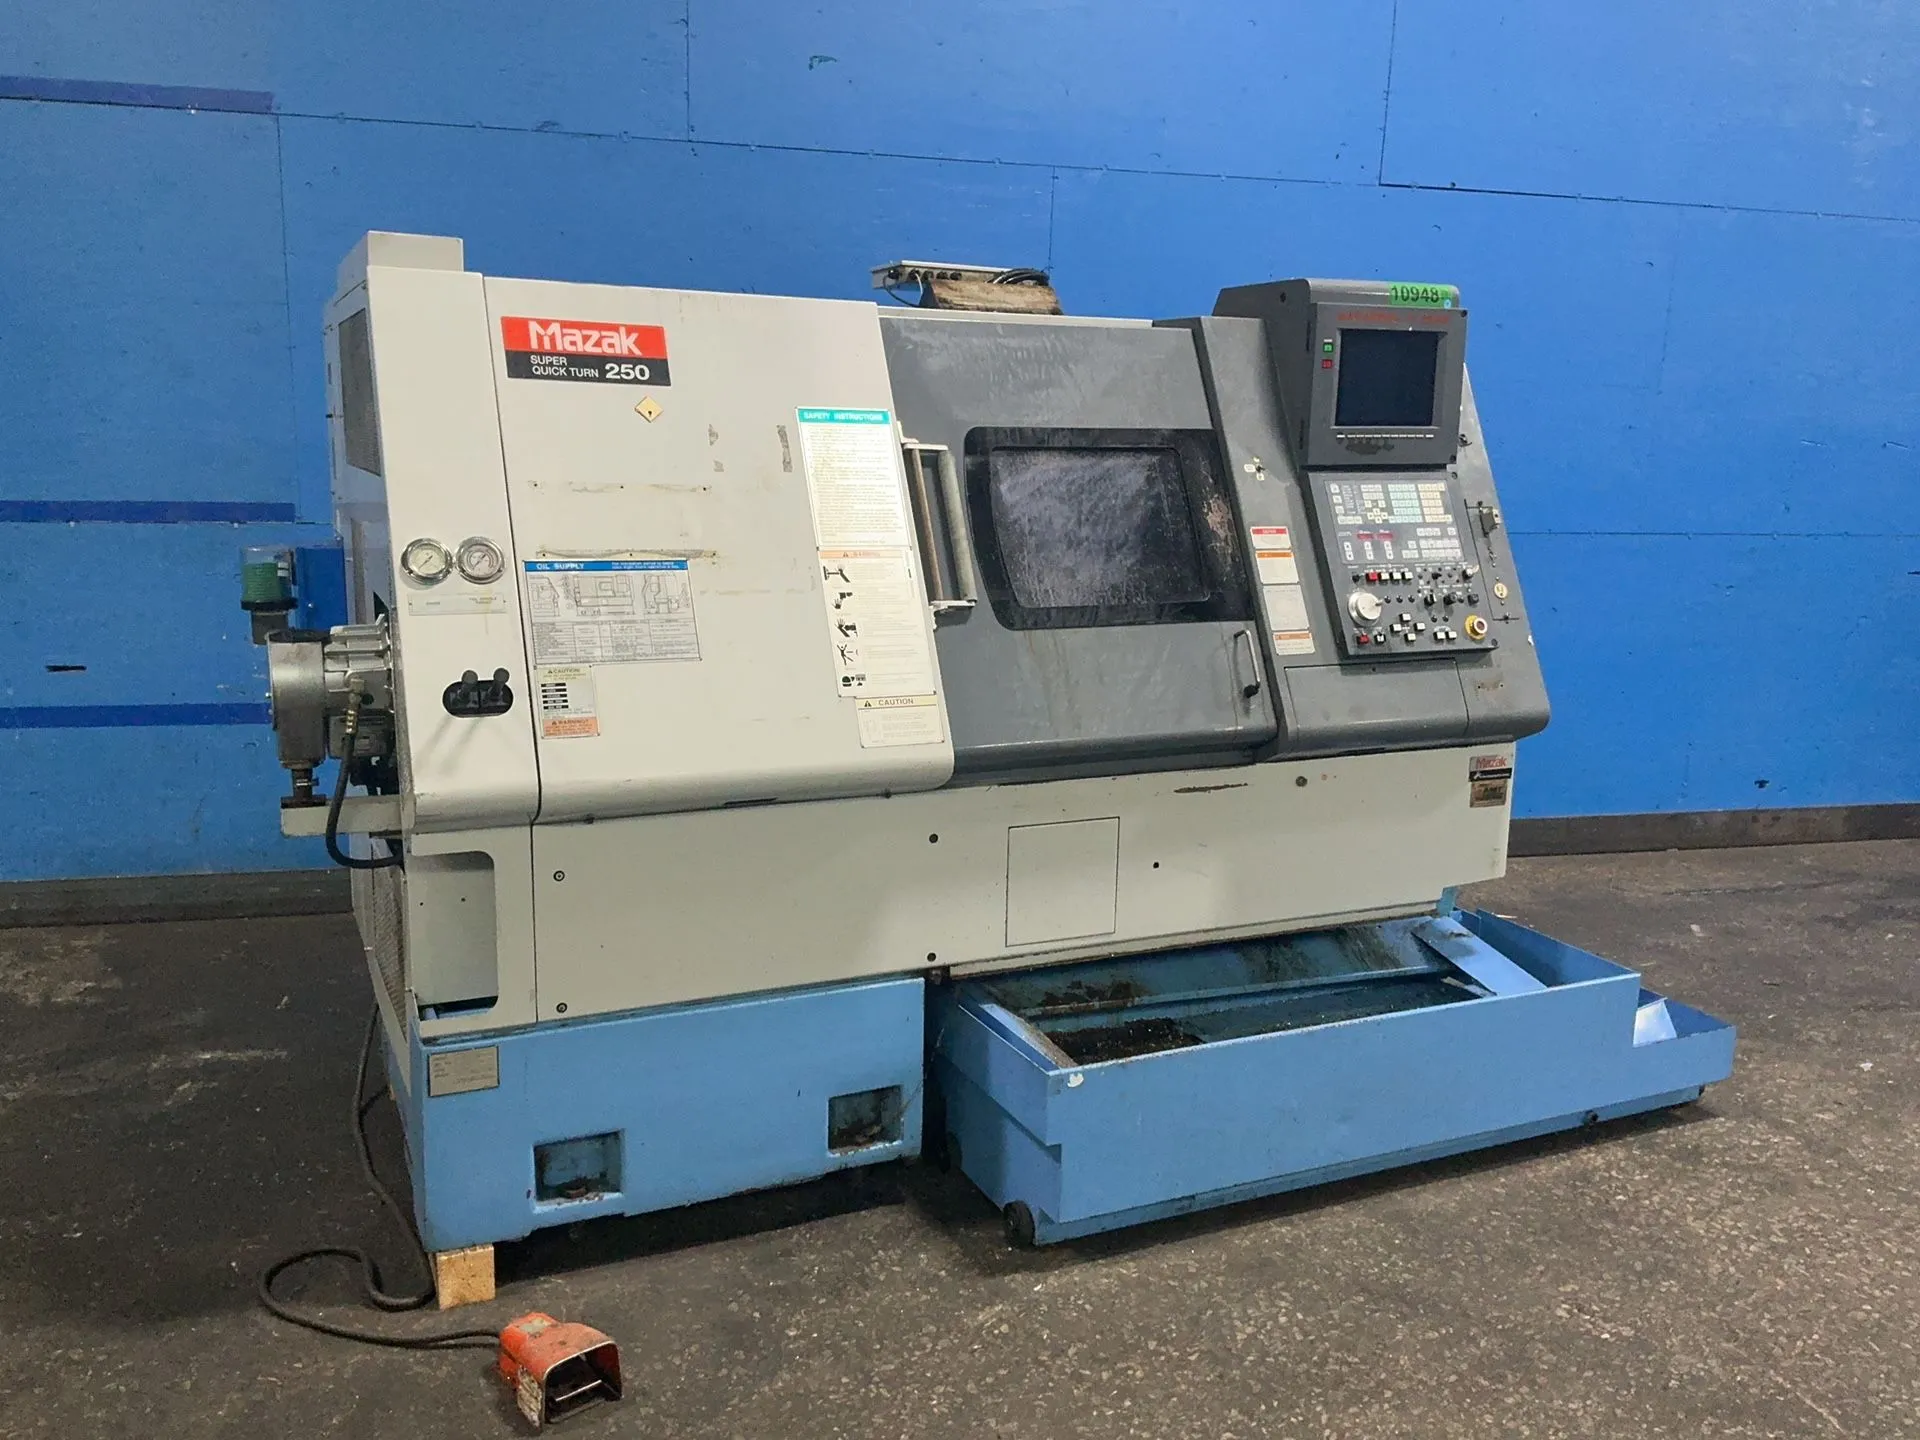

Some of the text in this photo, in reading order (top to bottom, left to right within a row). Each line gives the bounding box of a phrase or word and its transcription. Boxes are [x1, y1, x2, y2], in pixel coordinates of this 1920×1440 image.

[1391, 286, 1440, 303] 10948
[528, 320, 643, 356] Mazak
[530, 355, 568, 366] SUPER
[532, 363, 650, 381] QUICK TURN 250
[803, 411, 883, 422] SAFETY INSTRUCTIONS
[878, 698, 914, 706] CAUTION
